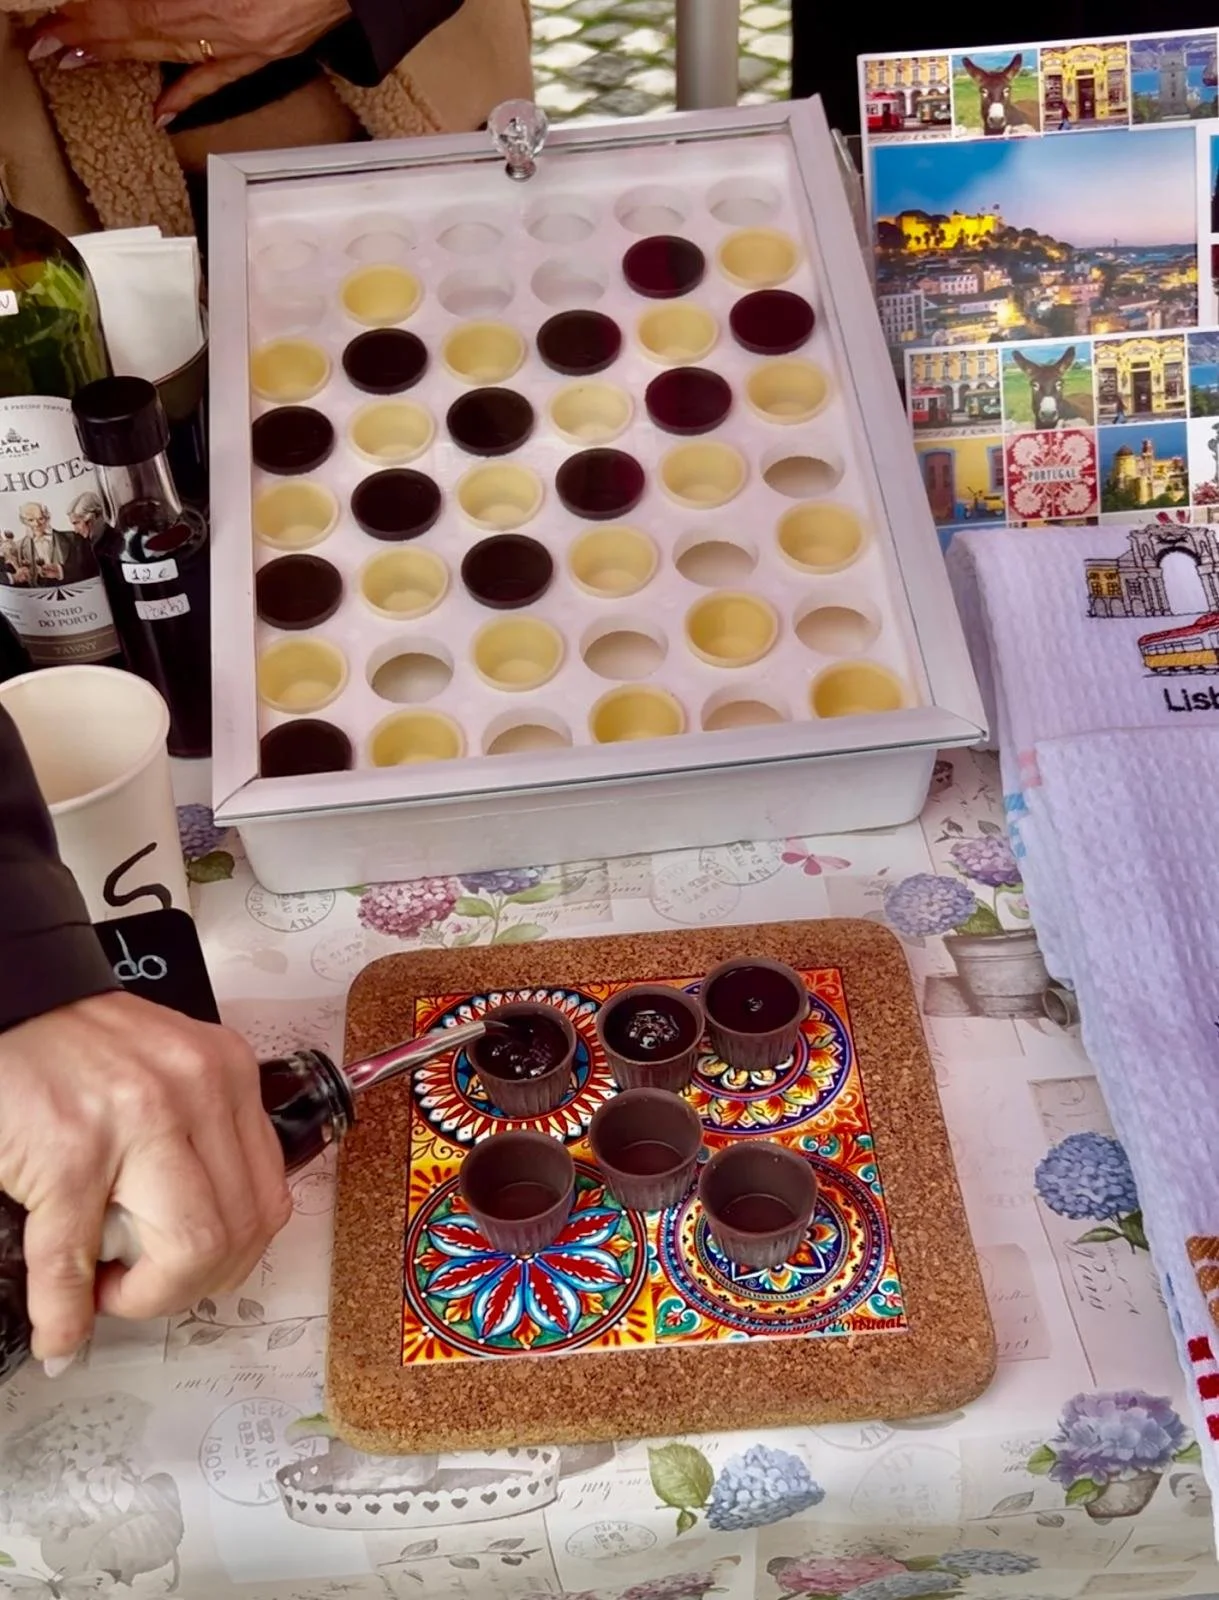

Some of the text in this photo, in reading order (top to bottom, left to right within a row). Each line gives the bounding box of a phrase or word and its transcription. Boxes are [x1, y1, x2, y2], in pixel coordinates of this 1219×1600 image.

[1028, 469, 1077, 481] PORTUGAL
[131, 568, 151, 582] 12
[44, 606, 83, 618] VINHO
[39, 613, 98, 628] DO PORTO
[54, 641, 97, 656] TAWNY
[241, 1401, 291, 1419] NEW
